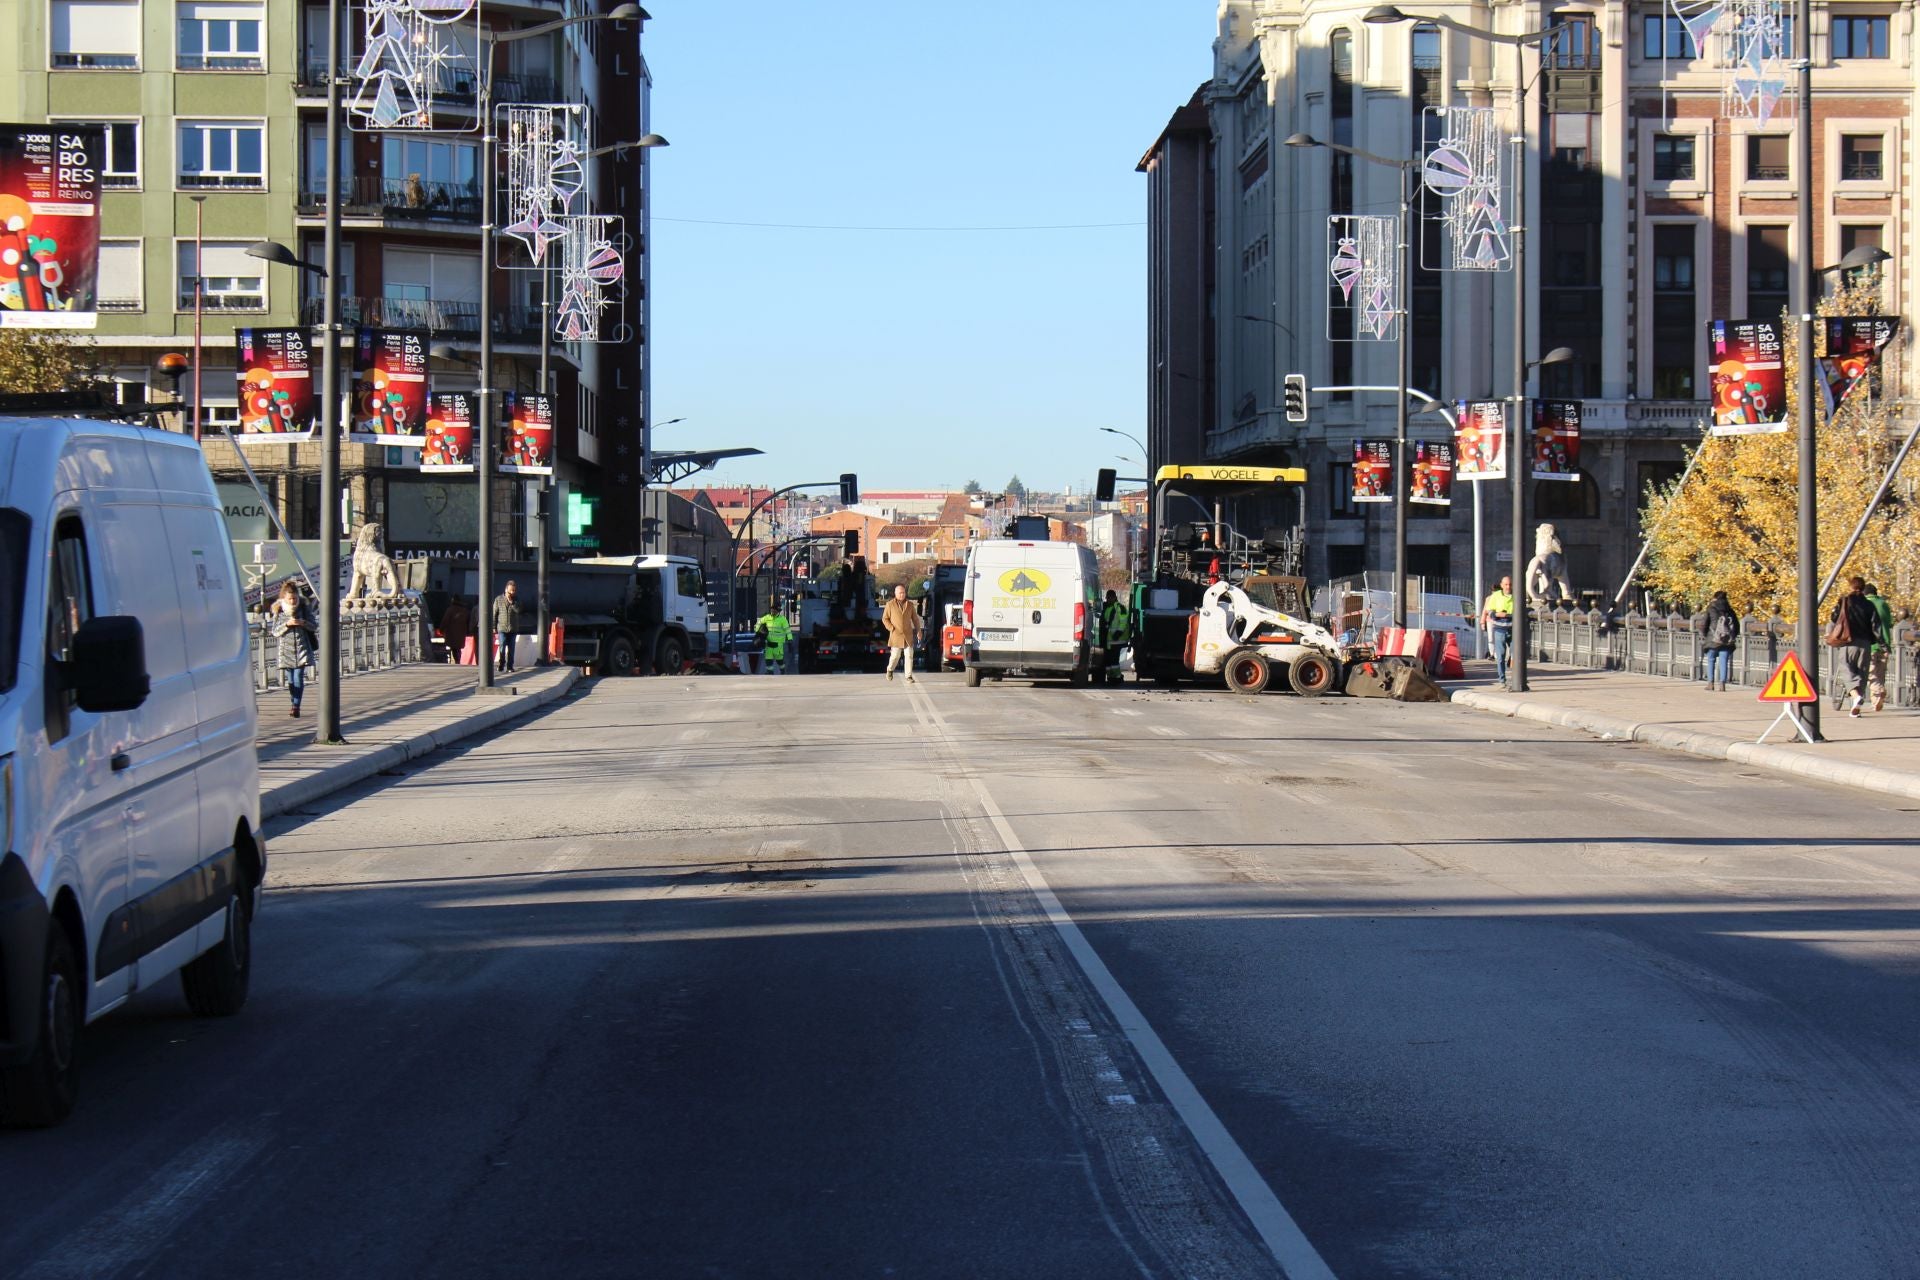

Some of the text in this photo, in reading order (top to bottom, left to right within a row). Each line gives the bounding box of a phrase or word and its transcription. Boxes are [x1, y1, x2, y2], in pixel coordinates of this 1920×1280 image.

[27, 134, 51, 143] XXXI
[59, 135, 85, 150] SA
[26, 144, 51, 153] Feria
[59, 152, 88, 166] BO
[59, 167, 95, 183] RES
[58, 190, 93, 200] REINO
[1758, 324, 1773, 333] SA
[1874, 321, 1889, 330] SA
[286, 332, 301, 341] SA
[405, 335, 419, 345] SA
[1758, 333, 1776, 342] BO
[287, 341, 303, 350] BO
[405, 345, 422, 354] BO
[1759, 342, 1781, 352] RES
[288, 350, 309, 361] RES
[404, 354, 425, 364] RES
